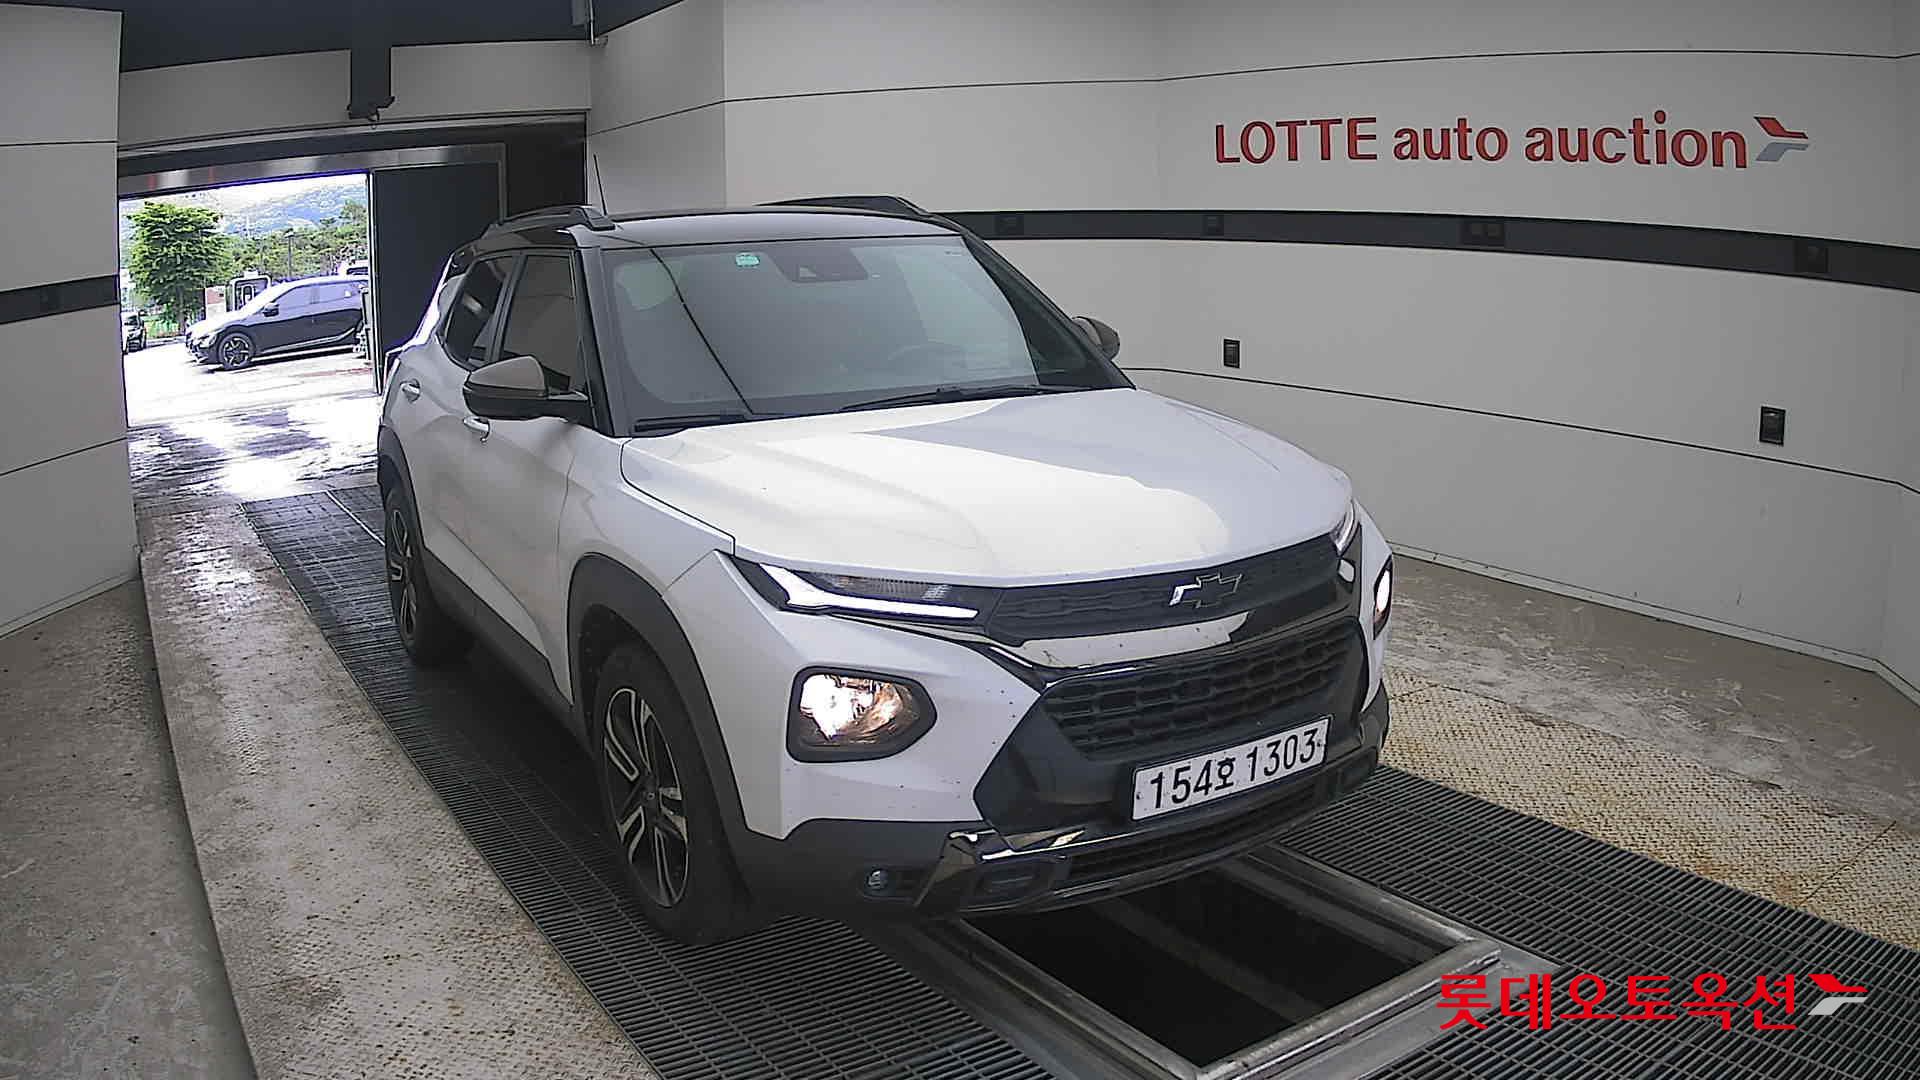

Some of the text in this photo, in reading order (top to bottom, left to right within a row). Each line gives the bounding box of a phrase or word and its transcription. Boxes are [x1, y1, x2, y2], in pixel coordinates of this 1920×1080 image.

[1215, 110, 1748, 168] LOTTE auto auction
[1150, 728, 1319, 809] 154호 1303
